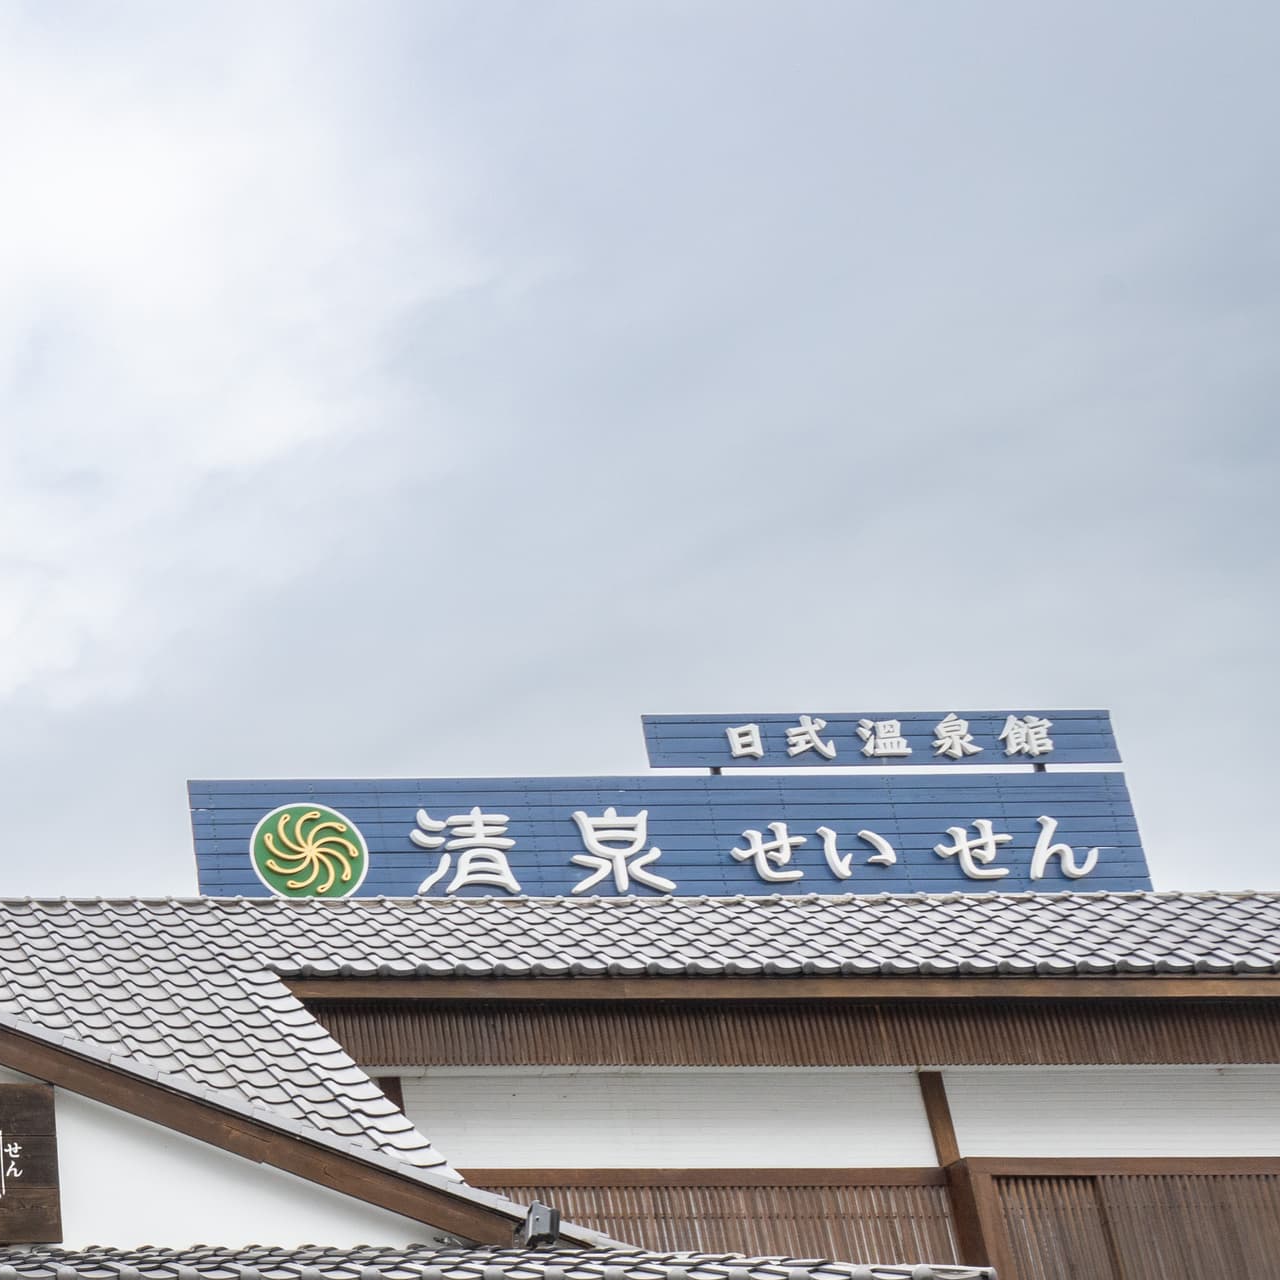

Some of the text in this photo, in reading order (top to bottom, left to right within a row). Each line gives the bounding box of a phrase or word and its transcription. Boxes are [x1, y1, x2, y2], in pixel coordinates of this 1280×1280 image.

[726, 712, 1054, 759] 日式溫泉館
[409, 806, 677, 895] 清泉
[4, 1142, 23, 1178] せん
